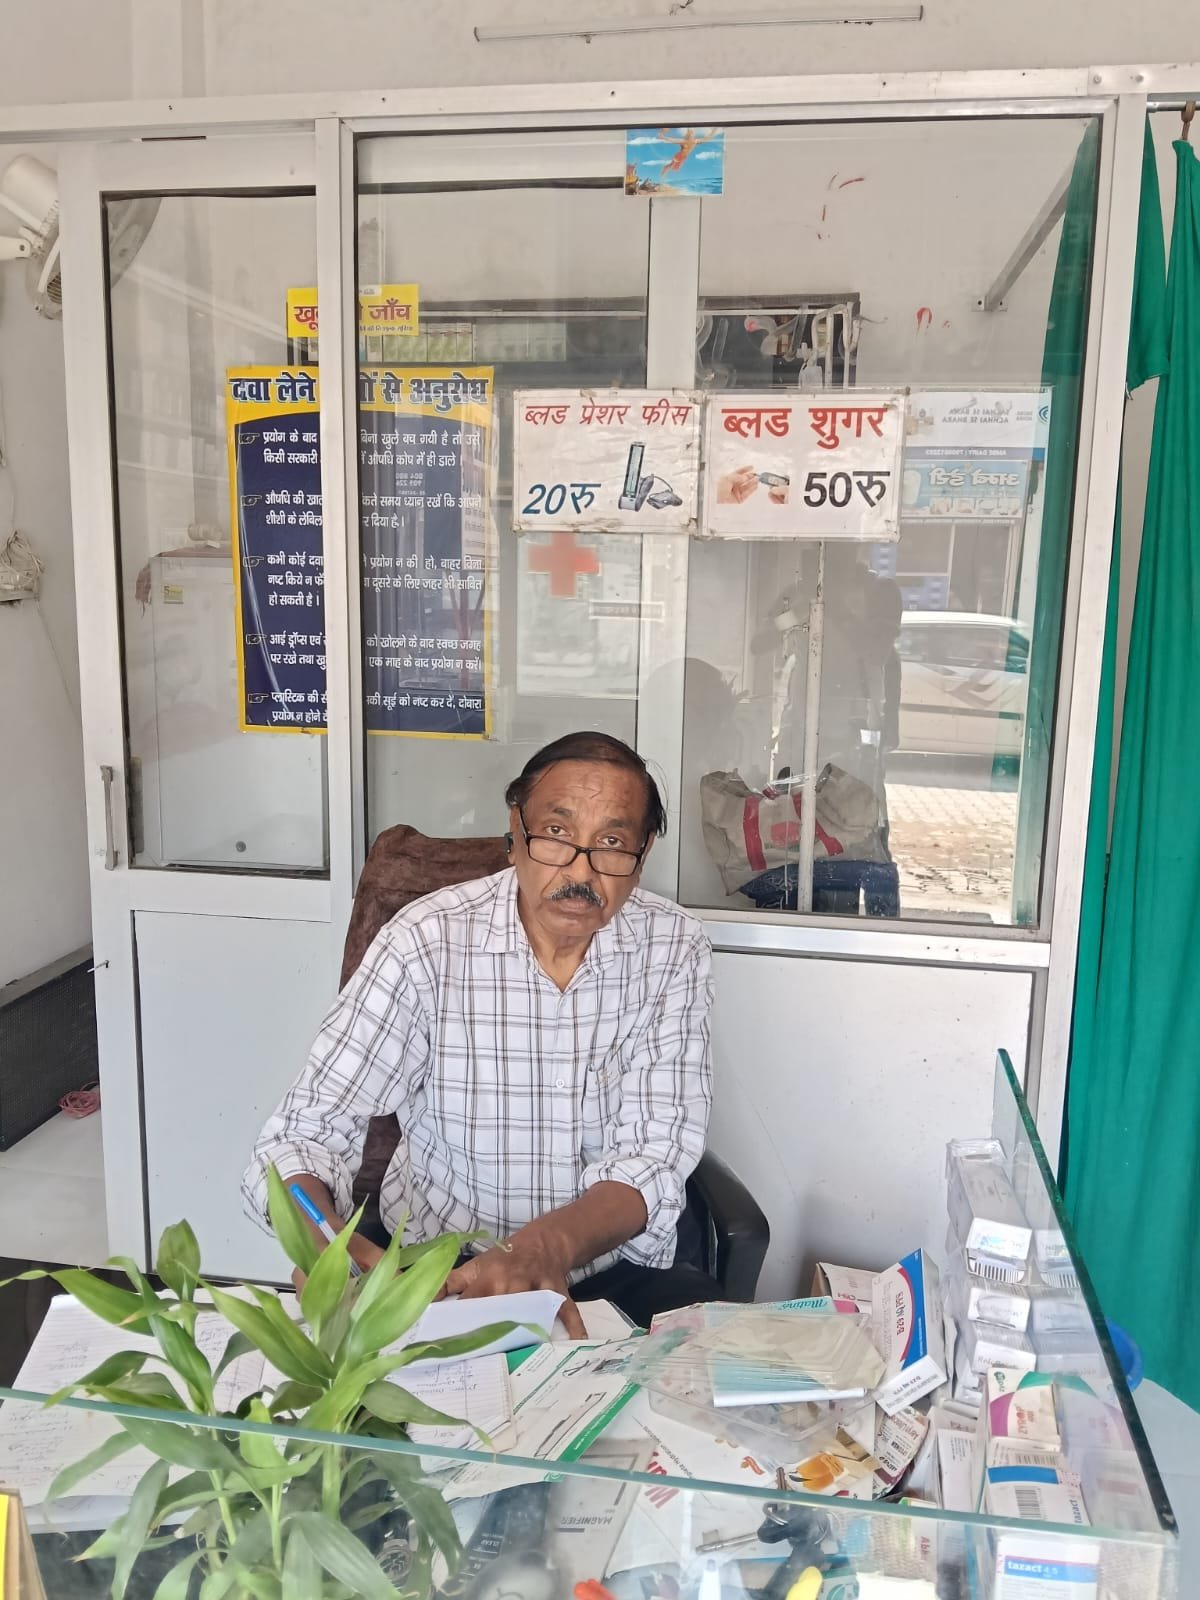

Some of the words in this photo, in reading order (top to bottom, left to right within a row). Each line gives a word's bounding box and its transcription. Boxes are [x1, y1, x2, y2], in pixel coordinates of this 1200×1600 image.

[294, 304, 318, 329] खू
[368, 298, 412, 321] जाँच
[229, 376, 271, 404] दवा
[275, 371, 316, 404] लेने
[380, 371, 403, 404] से
[409, 371, 489, 413] अनुरोध
[524, 405, 570, 425] ब्लड
[579, 398, 631, 425] प्रेशर
[642, 398, 692, 426] फीस
[262, 428, 285, 445] प्रयोग
[290, 429, 298, 443] के
[302, 431, 318, 443] बाद
[381, 429, 399, 449] खुले
[420, 430, 437, 445] गयी
[441, 430, 448, 445] है
[452, 430, 461, 445] तो
[721, 408, 792, 438] ब्लड
[808, 408, 888, 449] शुगर
[263, 448, 285, 464] किसी
[287, 449, 318, 464] सरकारी
[367, 450, 393, 466] औषधि
[396, 451, 413, 465] कोष
[416, 451, 425, 465] में
[427, 451, 435, 466] ही
[265, 490, 290, 505] औषधि
[292, 490, 304, 505] की
[380, 496, 401, 507] समय
[426, 493, 442, 508] रखें
[444, 493, 455, 508] कि
[522, 483, 601, 515] 20रु
[804, 471, 890, 508] 50रु
[266, 510, 285, 525] शीशी
[288, 511, 296, 525] के
[371, 513, 389, 528] दिया
[267, 551, 285, 565] कभी
[288, 551, 306, 567] कोई
[308, 555, 324, 566] दवा
[370, 554, 392, 569] प्रयोग
[395, 558, 403, 568] न
[406, 554, 418, 568] की
[440, 558, 461, 570] बाहर
[267, 574, 283, 585] नष्ट
[285, 571, 302, 585] किये
[305, 576, 312, 586] न
[372, 575, 390, 592] दूसरे
[393, 575, 402, 588] के
[404, 574, 420, 590] लिए
[422, 578, 442, 590] जहर
[443, 576, 455, 590] भी
[457, 576, 482, 590] साबित
[268, 592, 277, 606] हो
[279, 591, 304, 606] सकती
[306, 592, 313, 607] है
[270, 630, 286, 646] आई
[288, 632, 307, 648] ड्रॉप्स
[309, 632, 322, 646] एवं
[366, 634, 378, 647] को
[380, 634, 406, 648] खोलने
[408, 634, 417, 648] के
[419, 638, 434, 649] बाद
[460, 639, 481, 651] जगह
[270, 653, 281, 664] पर
[283, 650, 297, 664] रखे
[299, 654, 314, 664] तथा
[369, 656, 383, 667] एक
[385, 657, 401, 669] माह
[403, 655, 412, 667] के
[414, 658, 429, 669] बाद
[431, 655, 454, 670] प्रयोग
[455, 659, 463, 669] न
[271, 688, 305, 703] प्लास्टिक
[307, 690, 318, 703] की
[383, 692, 397, 711] सूई
[399, 693, 410, 706] को
[412, 696, 429, 707] नष्ट
[430, 697, 444, 708] कर
[458, 695, 482, 709] दोबारा
[272, 708, 295, 722] प्रयोग
[295, 711, 303, 721] न
[305, 708, 320, 723] होने
[561, 1516, 613, 1525] MAGNIFIER
[1007, 1561, 1043, 1573] tazact
